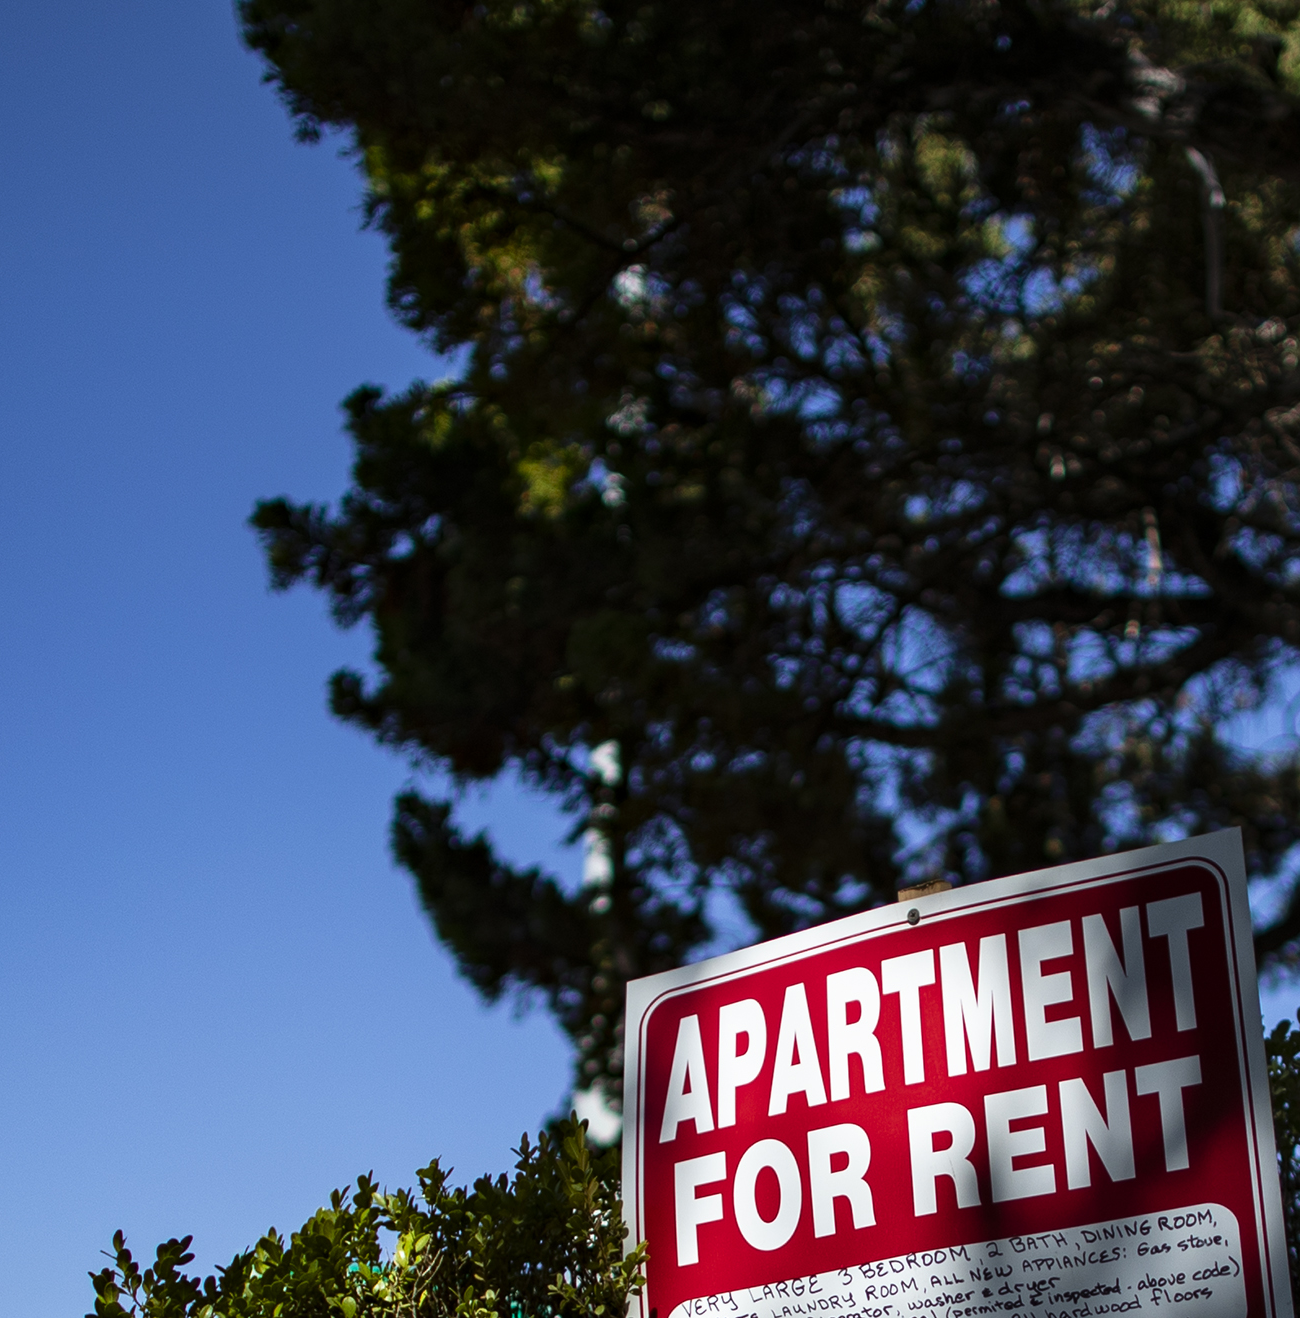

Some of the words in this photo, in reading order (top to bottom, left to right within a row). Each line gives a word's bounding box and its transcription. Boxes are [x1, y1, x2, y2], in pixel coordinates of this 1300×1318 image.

[659, 891, 1205, 1143] APARTMENT
[673, 1122, 877, 1267] FOR
[906, 1054, 1202, 1217] RENT
[682, 1292, 738, 1318] VERY
[749, 1275, 823, 1303] LARGE
[838, 1268, 853, 1286] 3
[1081, 1220, 1152, 1243] DINING
[1158, 1209, 1217, 1231] ROOM,
[771, 1292, 856, 1318] LAUNDRY
[865, 1277, 927, 1301] ROOM,
[930, 1273, 964, 1288] ALL
[969, 1264, 1013, 1282] NEW
[1137, 1242, 1171, 1256] Gas
[908, 1290, 975, 1311] washer
[998, 1277, 1060, 1299] dryer
[1048, 1277, 1121, 1305] inspected
[1137, 1273, 1186, 1291] above
[1192, 1255, 1241, 1281] code)
[1150, 1287, 1213, 1306] floors
